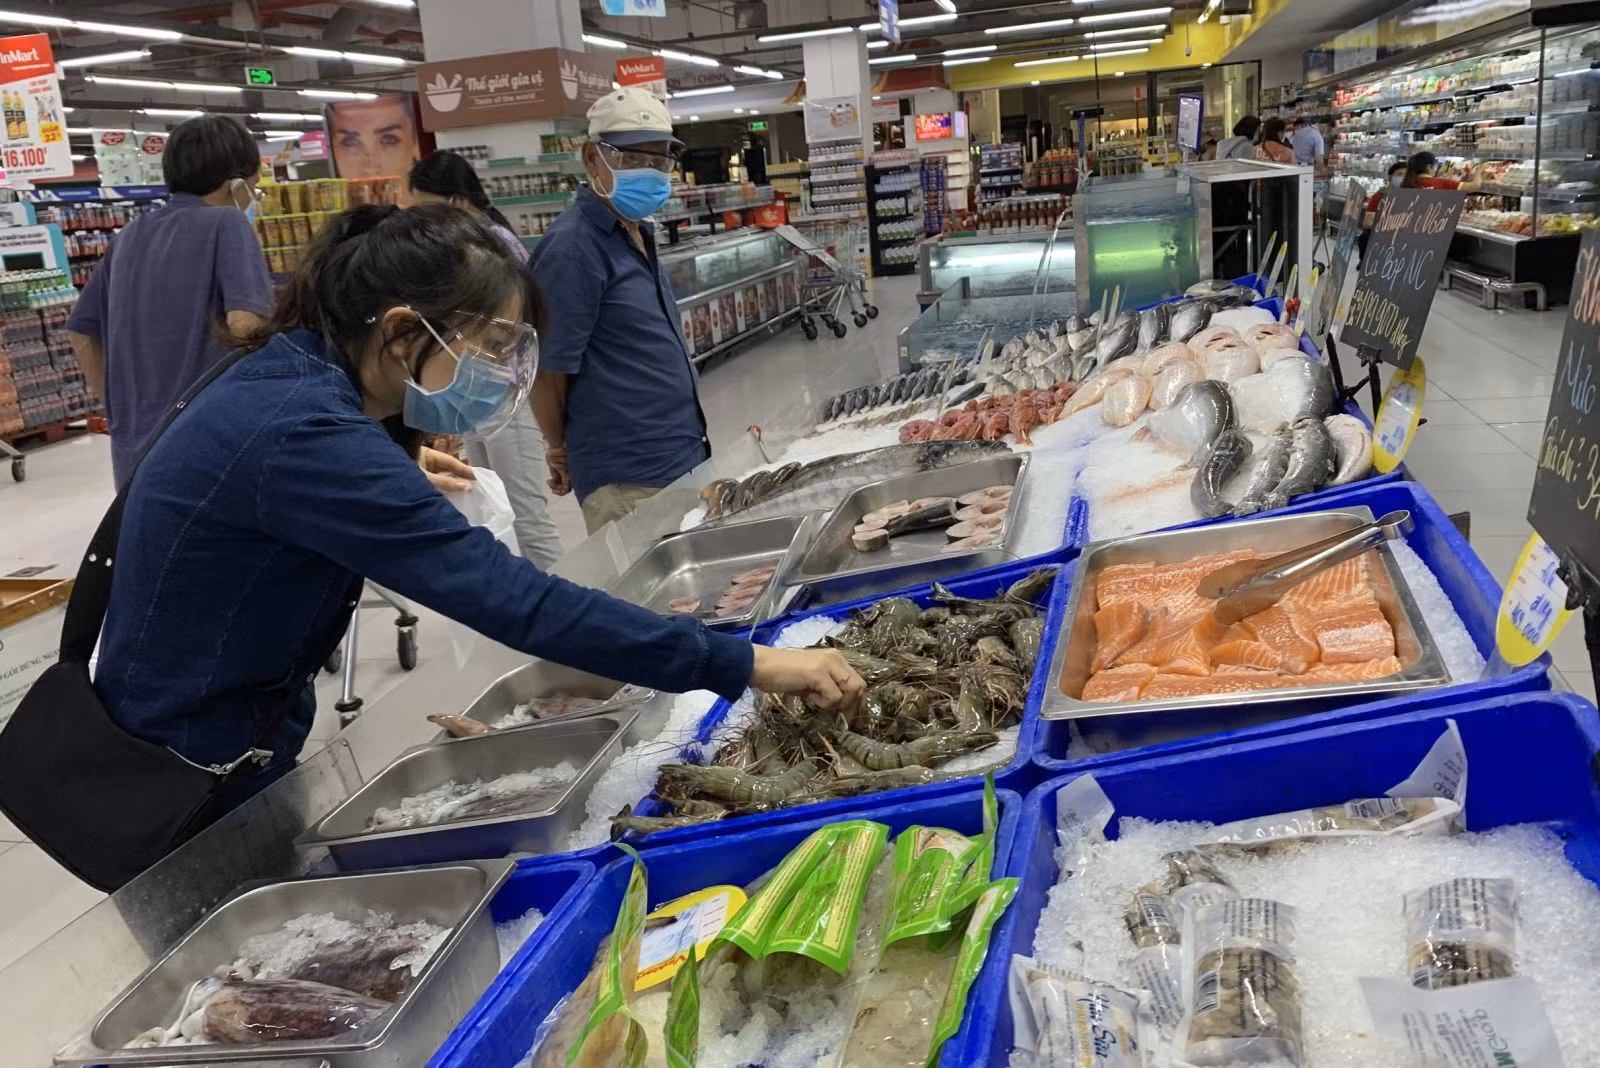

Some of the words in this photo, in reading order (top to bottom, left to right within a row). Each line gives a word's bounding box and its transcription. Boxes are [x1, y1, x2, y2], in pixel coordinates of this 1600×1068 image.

[620, 64, 655, 76] VinMart
[465, 75, 487, 91] Thế
[511, 72, 530, 90] gia
